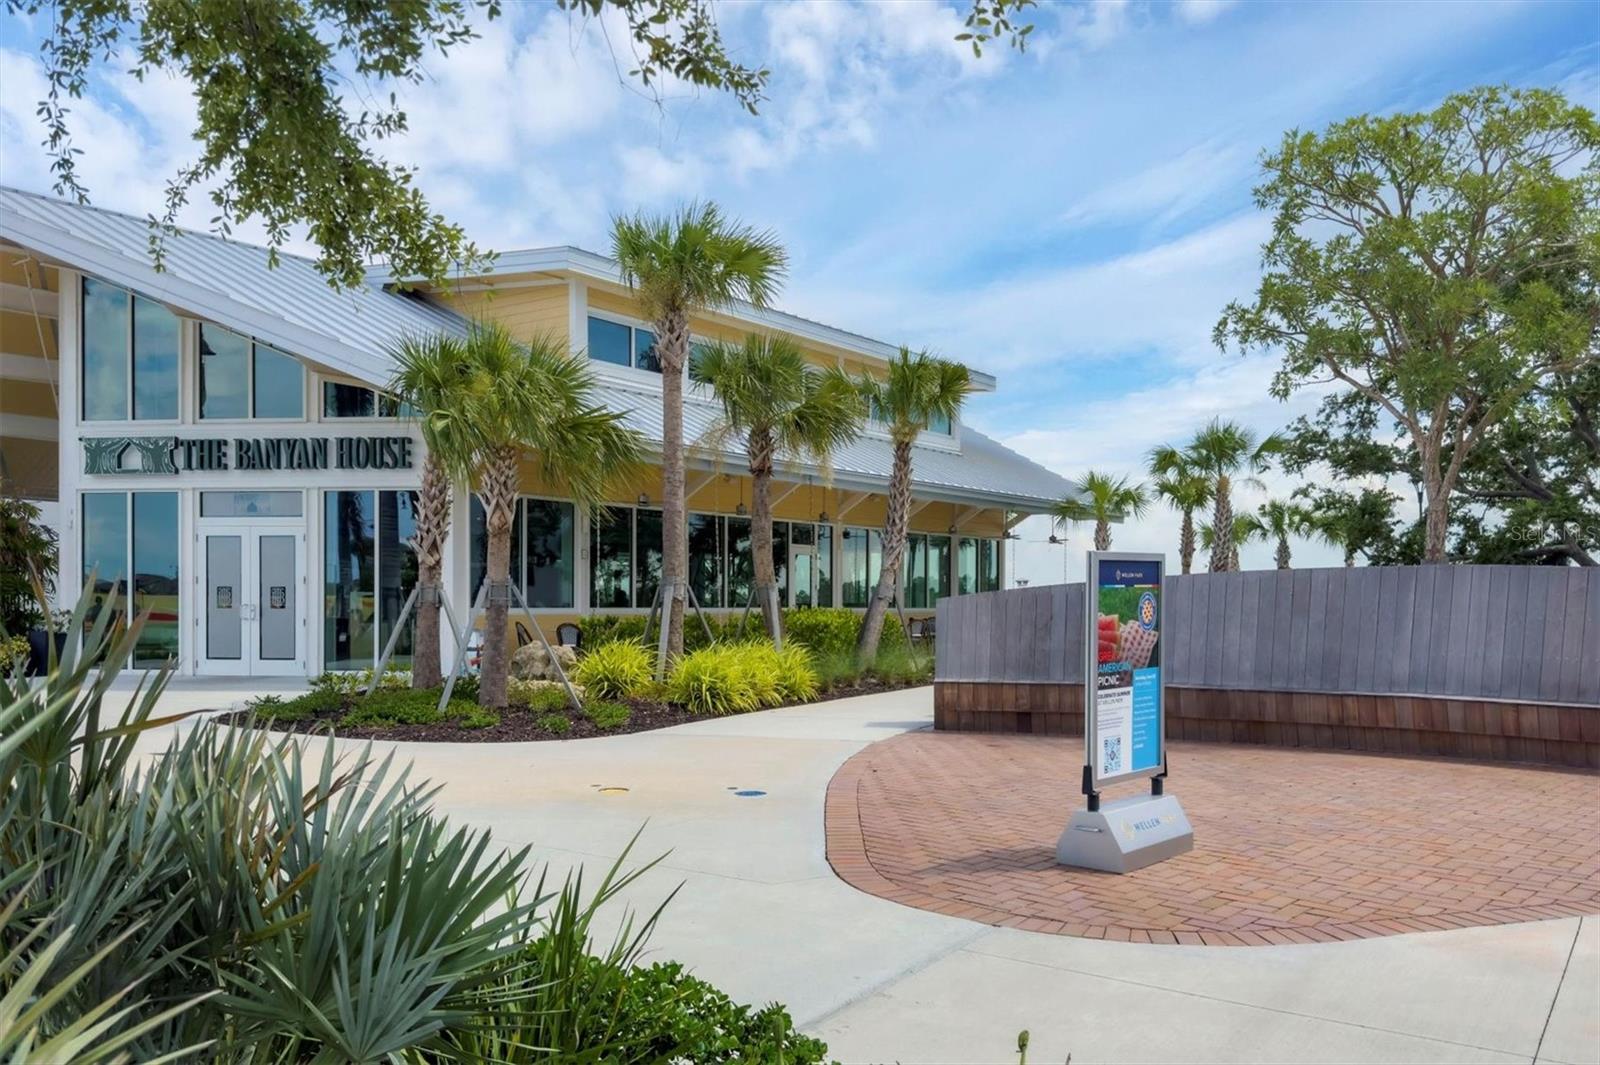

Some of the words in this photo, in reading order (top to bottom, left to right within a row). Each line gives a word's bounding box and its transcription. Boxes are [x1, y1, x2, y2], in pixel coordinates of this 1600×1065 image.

[179, 439, 228, 471] THE
[234, 438, 328, 471] BANYAN
[335, 437, 413, 469] HOUSE
[1098, 675, 1120, 686] PICNIC
[1133, 817, 1160, 830] WELLEN
